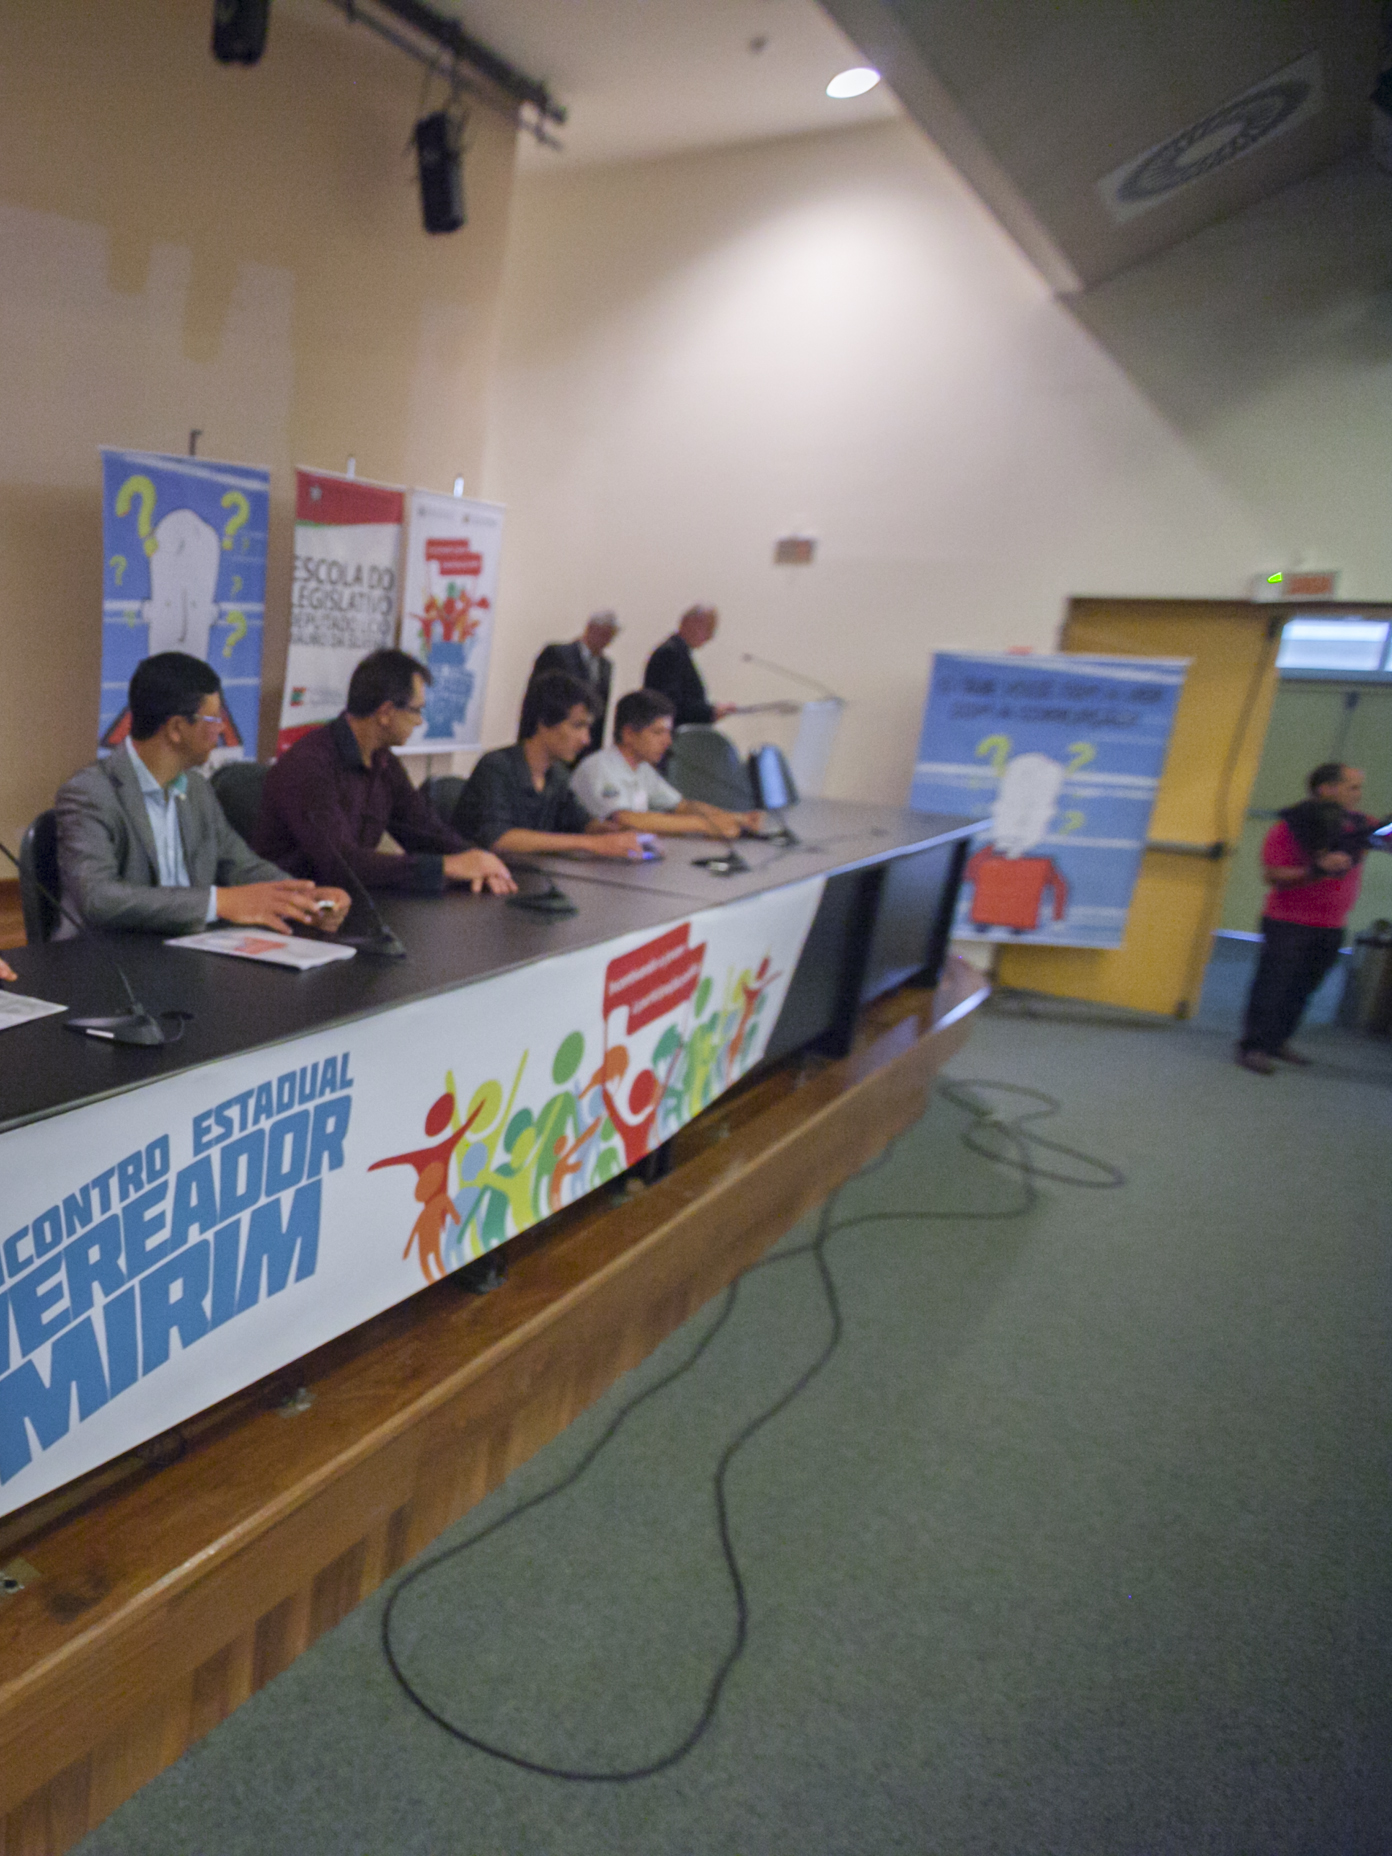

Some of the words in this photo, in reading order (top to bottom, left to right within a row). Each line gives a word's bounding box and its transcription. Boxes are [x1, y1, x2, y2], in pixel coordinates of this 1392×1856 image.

[292, 556, 363, 587] ESCOLA
[368, 565, 396, 592] DO
[192, 1051, 354, 1158] ESTADUAL
